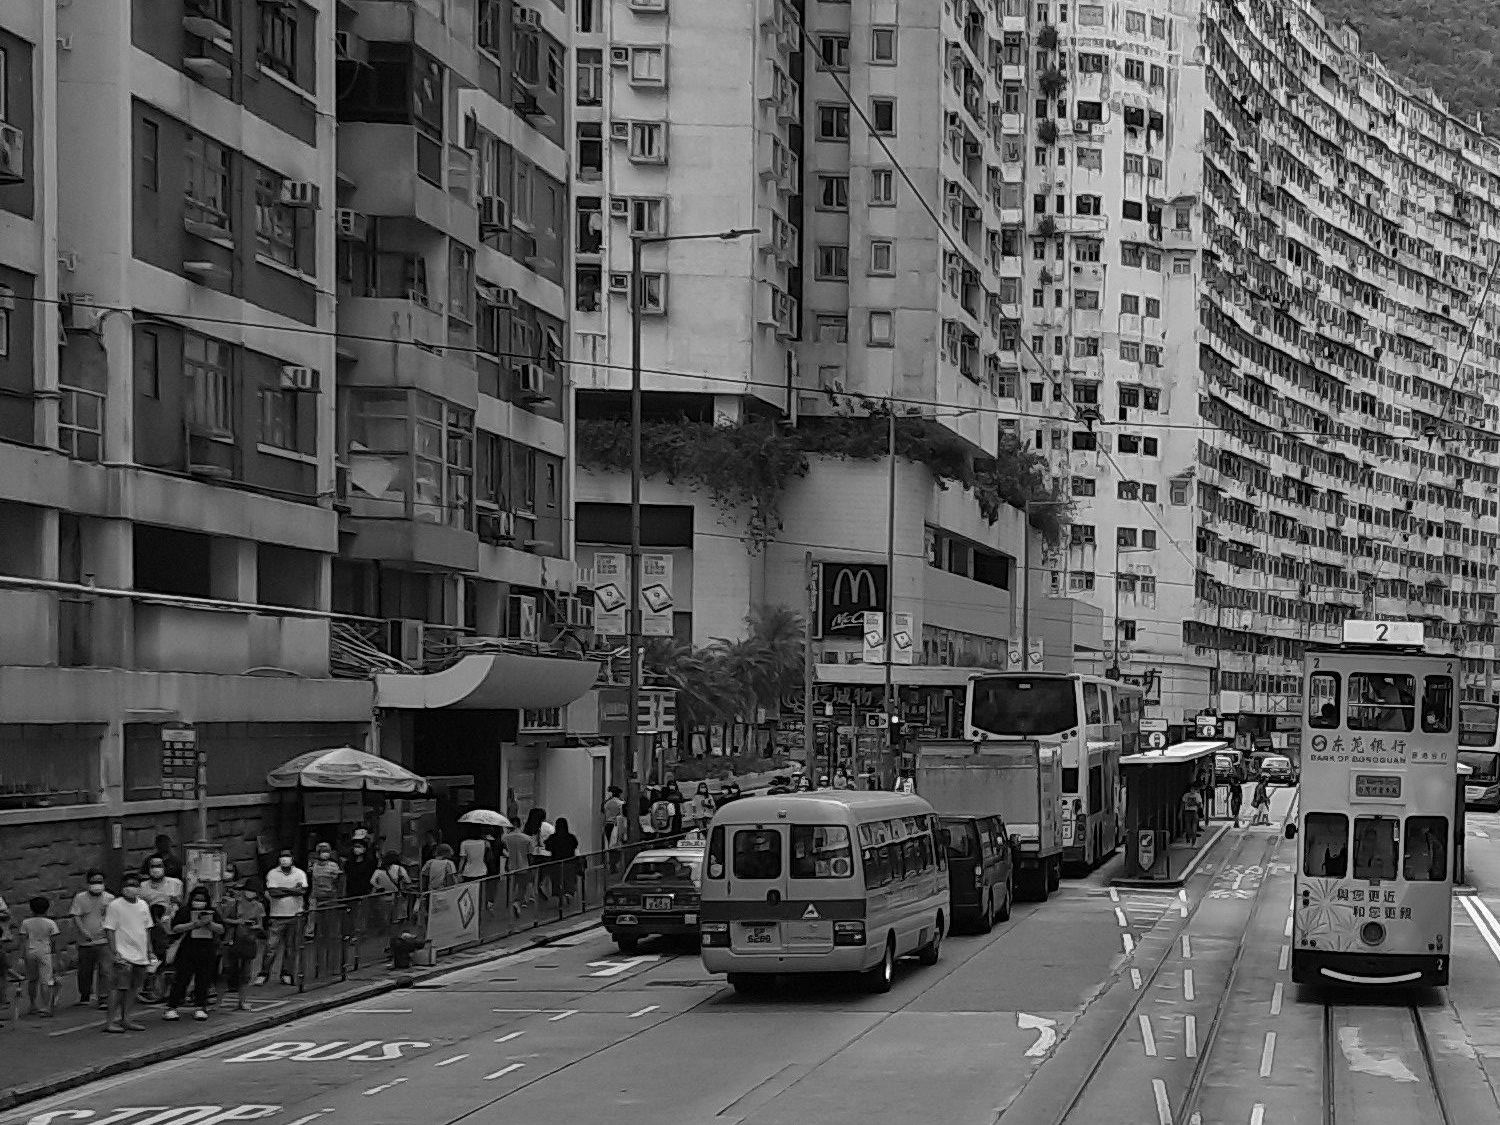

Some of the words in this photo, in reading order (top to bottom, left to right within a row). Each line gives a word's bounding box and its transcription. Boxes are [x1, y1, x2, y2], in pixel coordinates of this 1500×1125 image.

[1376, 624, 1389, 641] 2
[1313, 658, 1320, 668] 2
[1446, 662, 1453, 673] 2
[1310, 754, 1335, 762] BANK
[1337, 755, 1349, 763] OF
[1352, 756, 1407, 764] DONGGUAN
[1436, 958, 1443, 971] 2
[224, 1041, 431, 1063] BUS
